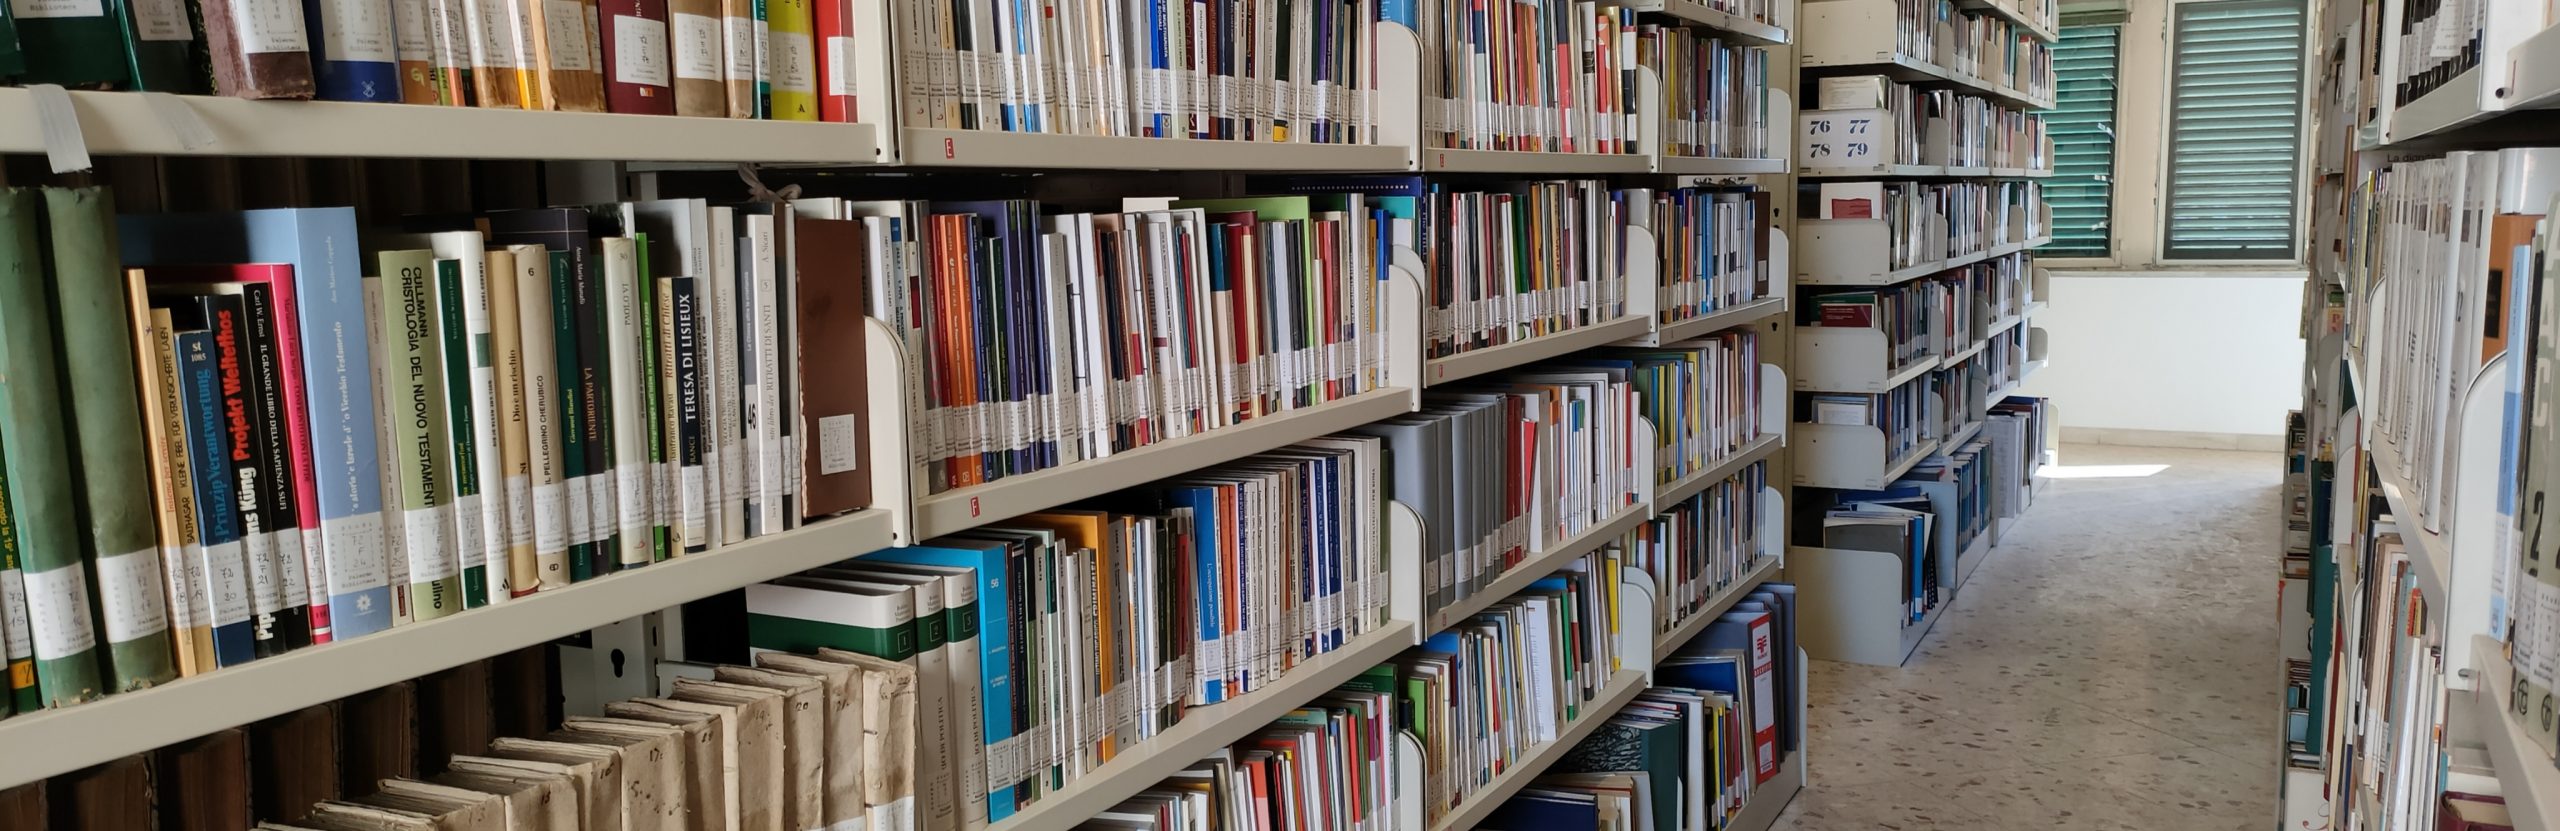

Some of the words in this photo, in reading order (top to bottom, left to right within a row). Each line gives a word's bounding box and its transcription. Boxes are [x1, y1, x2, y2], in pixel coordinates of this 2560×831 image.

[1810, 120, 1831, 135] 76
[1849, 119, 1871, 134] 77
[1810, 143, 1831, 158] 78
[1847, 142, 1868, 157] 79
[527, 267, 535, 277] 6
[577, 263, 585, 281] Maria
[253, 288, 262, 309] Carl
[413, 266, 428, 338] CULLMANN
[621, 283, 629, 295] VI
[255, 308, 264, 318] W.
[401, 267, 418, 352] CRISTOLOGIA
[622, 294, 632, 326] PAOLO
[679, 294, 693, 348] LISIEUX
[763, 304, 771, 336] SANTI
[332, 321, 347, 374] Testamento
[682, 351, 694, 368] DI
[261, 354, 273, 395] GRANDE
[410, 356, 421, 381] DEL
[508, 348, 518, 382] rischio
[583, 367, 593, 380] LA
[162, 354, 179, 417] VERUNSICHERTE
[536, 375, 547, 424] CHERUBICO
[682, 371, 697, 424] TERESA
[266, 394, 277, 419] LIBRO
[413, 383, 429, 429] NUOVO
[511, 404, 521, 422] Dio
[584, 381, 597, 442] PARTORIENTE
[196, 368, 223, 482] Verantwortung
[226, 398, 251, 462] Projekt
[269, 420, 279, 447] DELLA
[668, 420, 677, 462] ianfranco
[174, 438, 185, 458] FIBEL
[540, 424, 551, 475] PELLEGRINO
[176, 461, 189, 489] KLEINE
[271, 447, 284, 492] SAPIENZA
[417, 433, 435, 507] TESTAMENT
[544, 474, 552, 485] IL
[163, 477, 176, 513] Insieme
[237, 466, 258, 511] Küng
[277, 492, 287, 511] SUFI
[180, 496, 195, 545] BALTHASAR
[208, 476, 231, 539] Prinzip
[431, 579, 444, 609] ulino
